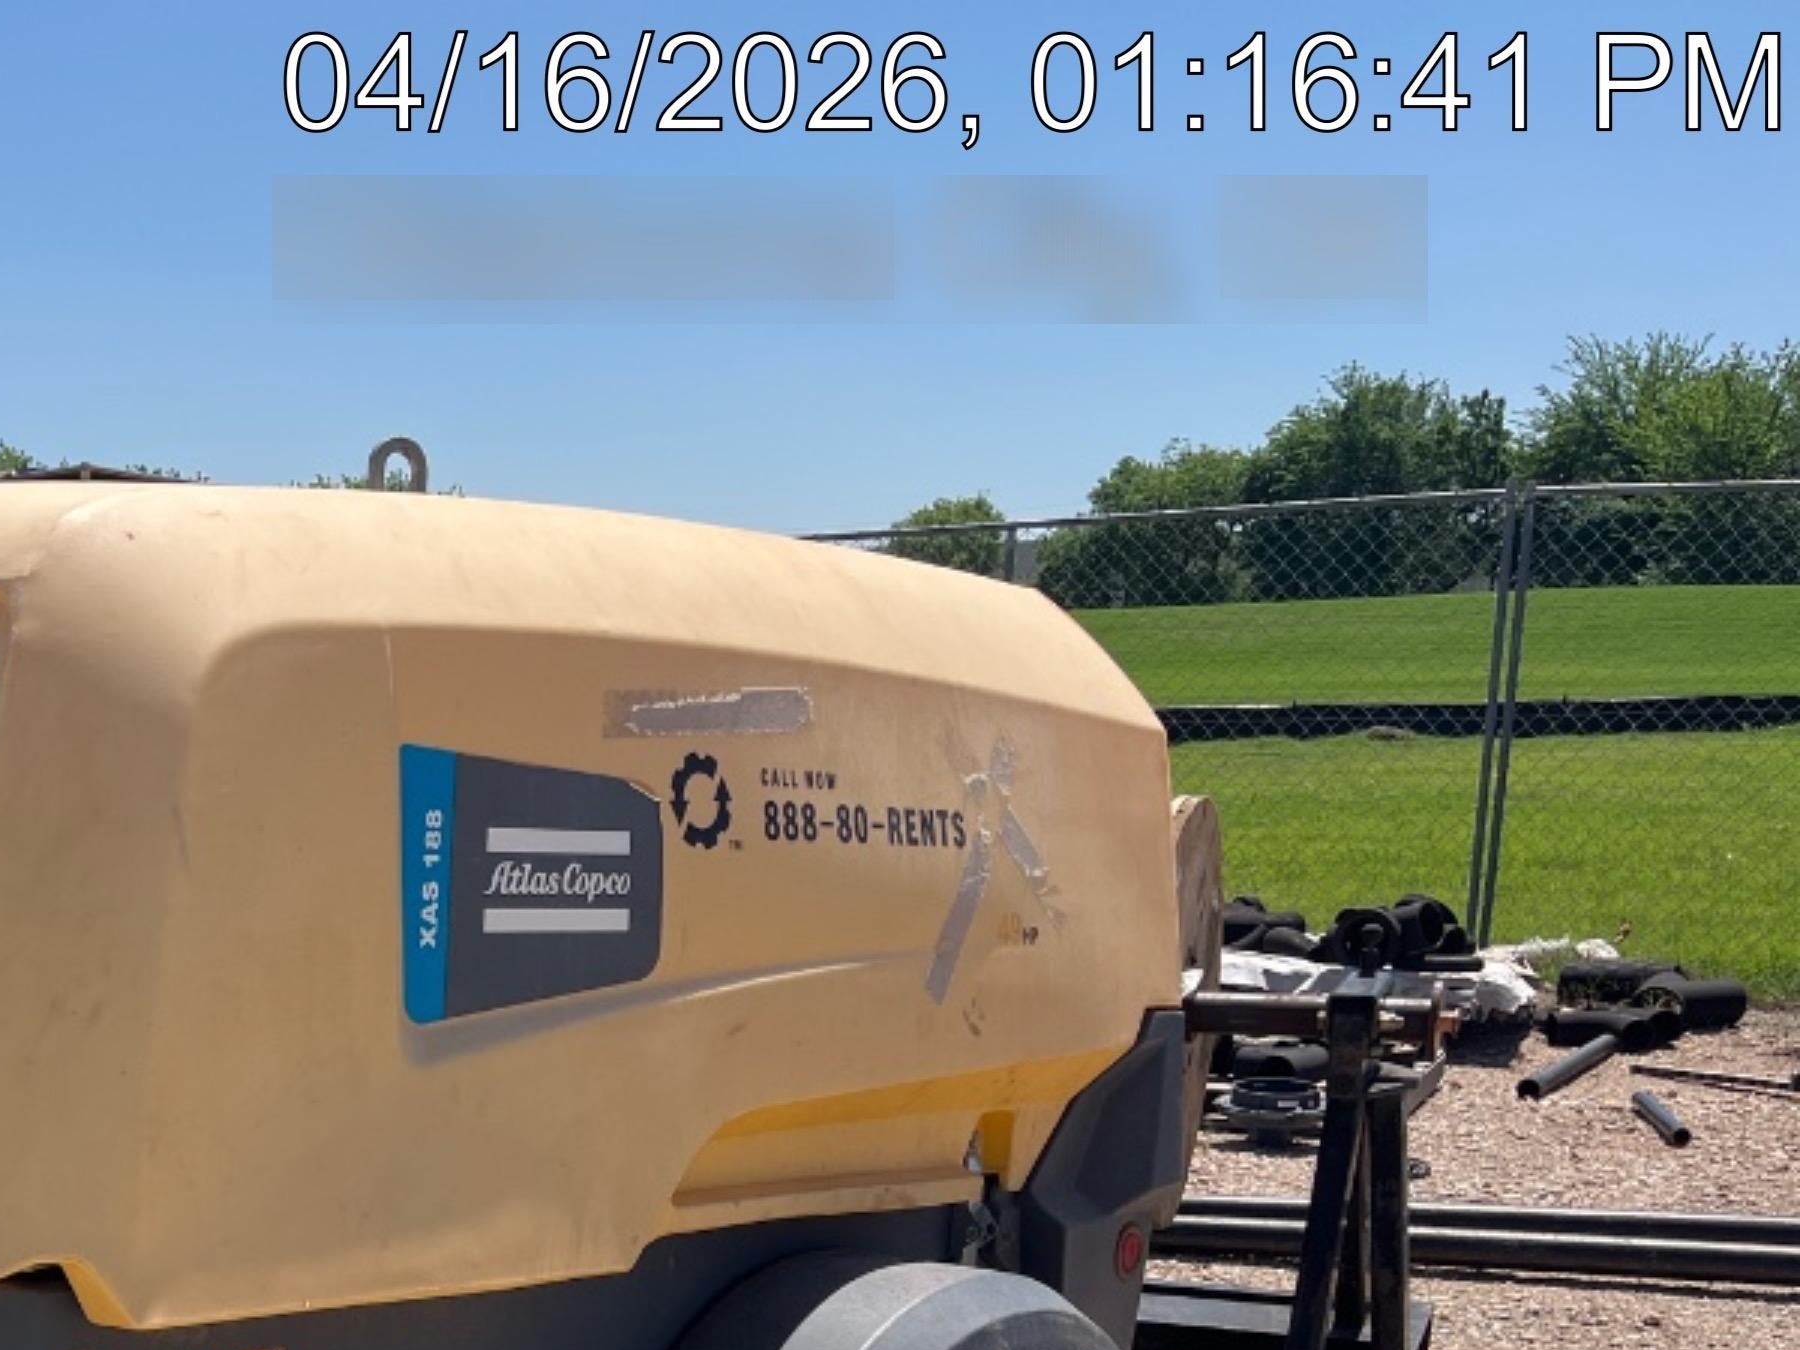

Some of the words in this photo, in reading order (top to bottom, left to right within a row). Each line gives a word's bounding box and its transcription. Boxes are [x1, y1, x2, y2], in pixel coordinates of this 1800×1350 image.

[761, 767, 799, 788] CALL
[804, 770, 837, 790] NOW
[422, 809, 443, 868] 188
[763, 800, 968, 849] 888-80-RENTS
[482, 860, 560, 895] Atlas
[562, 862, 631, 904] Copco
[419, 880, 440, 949] XAS
